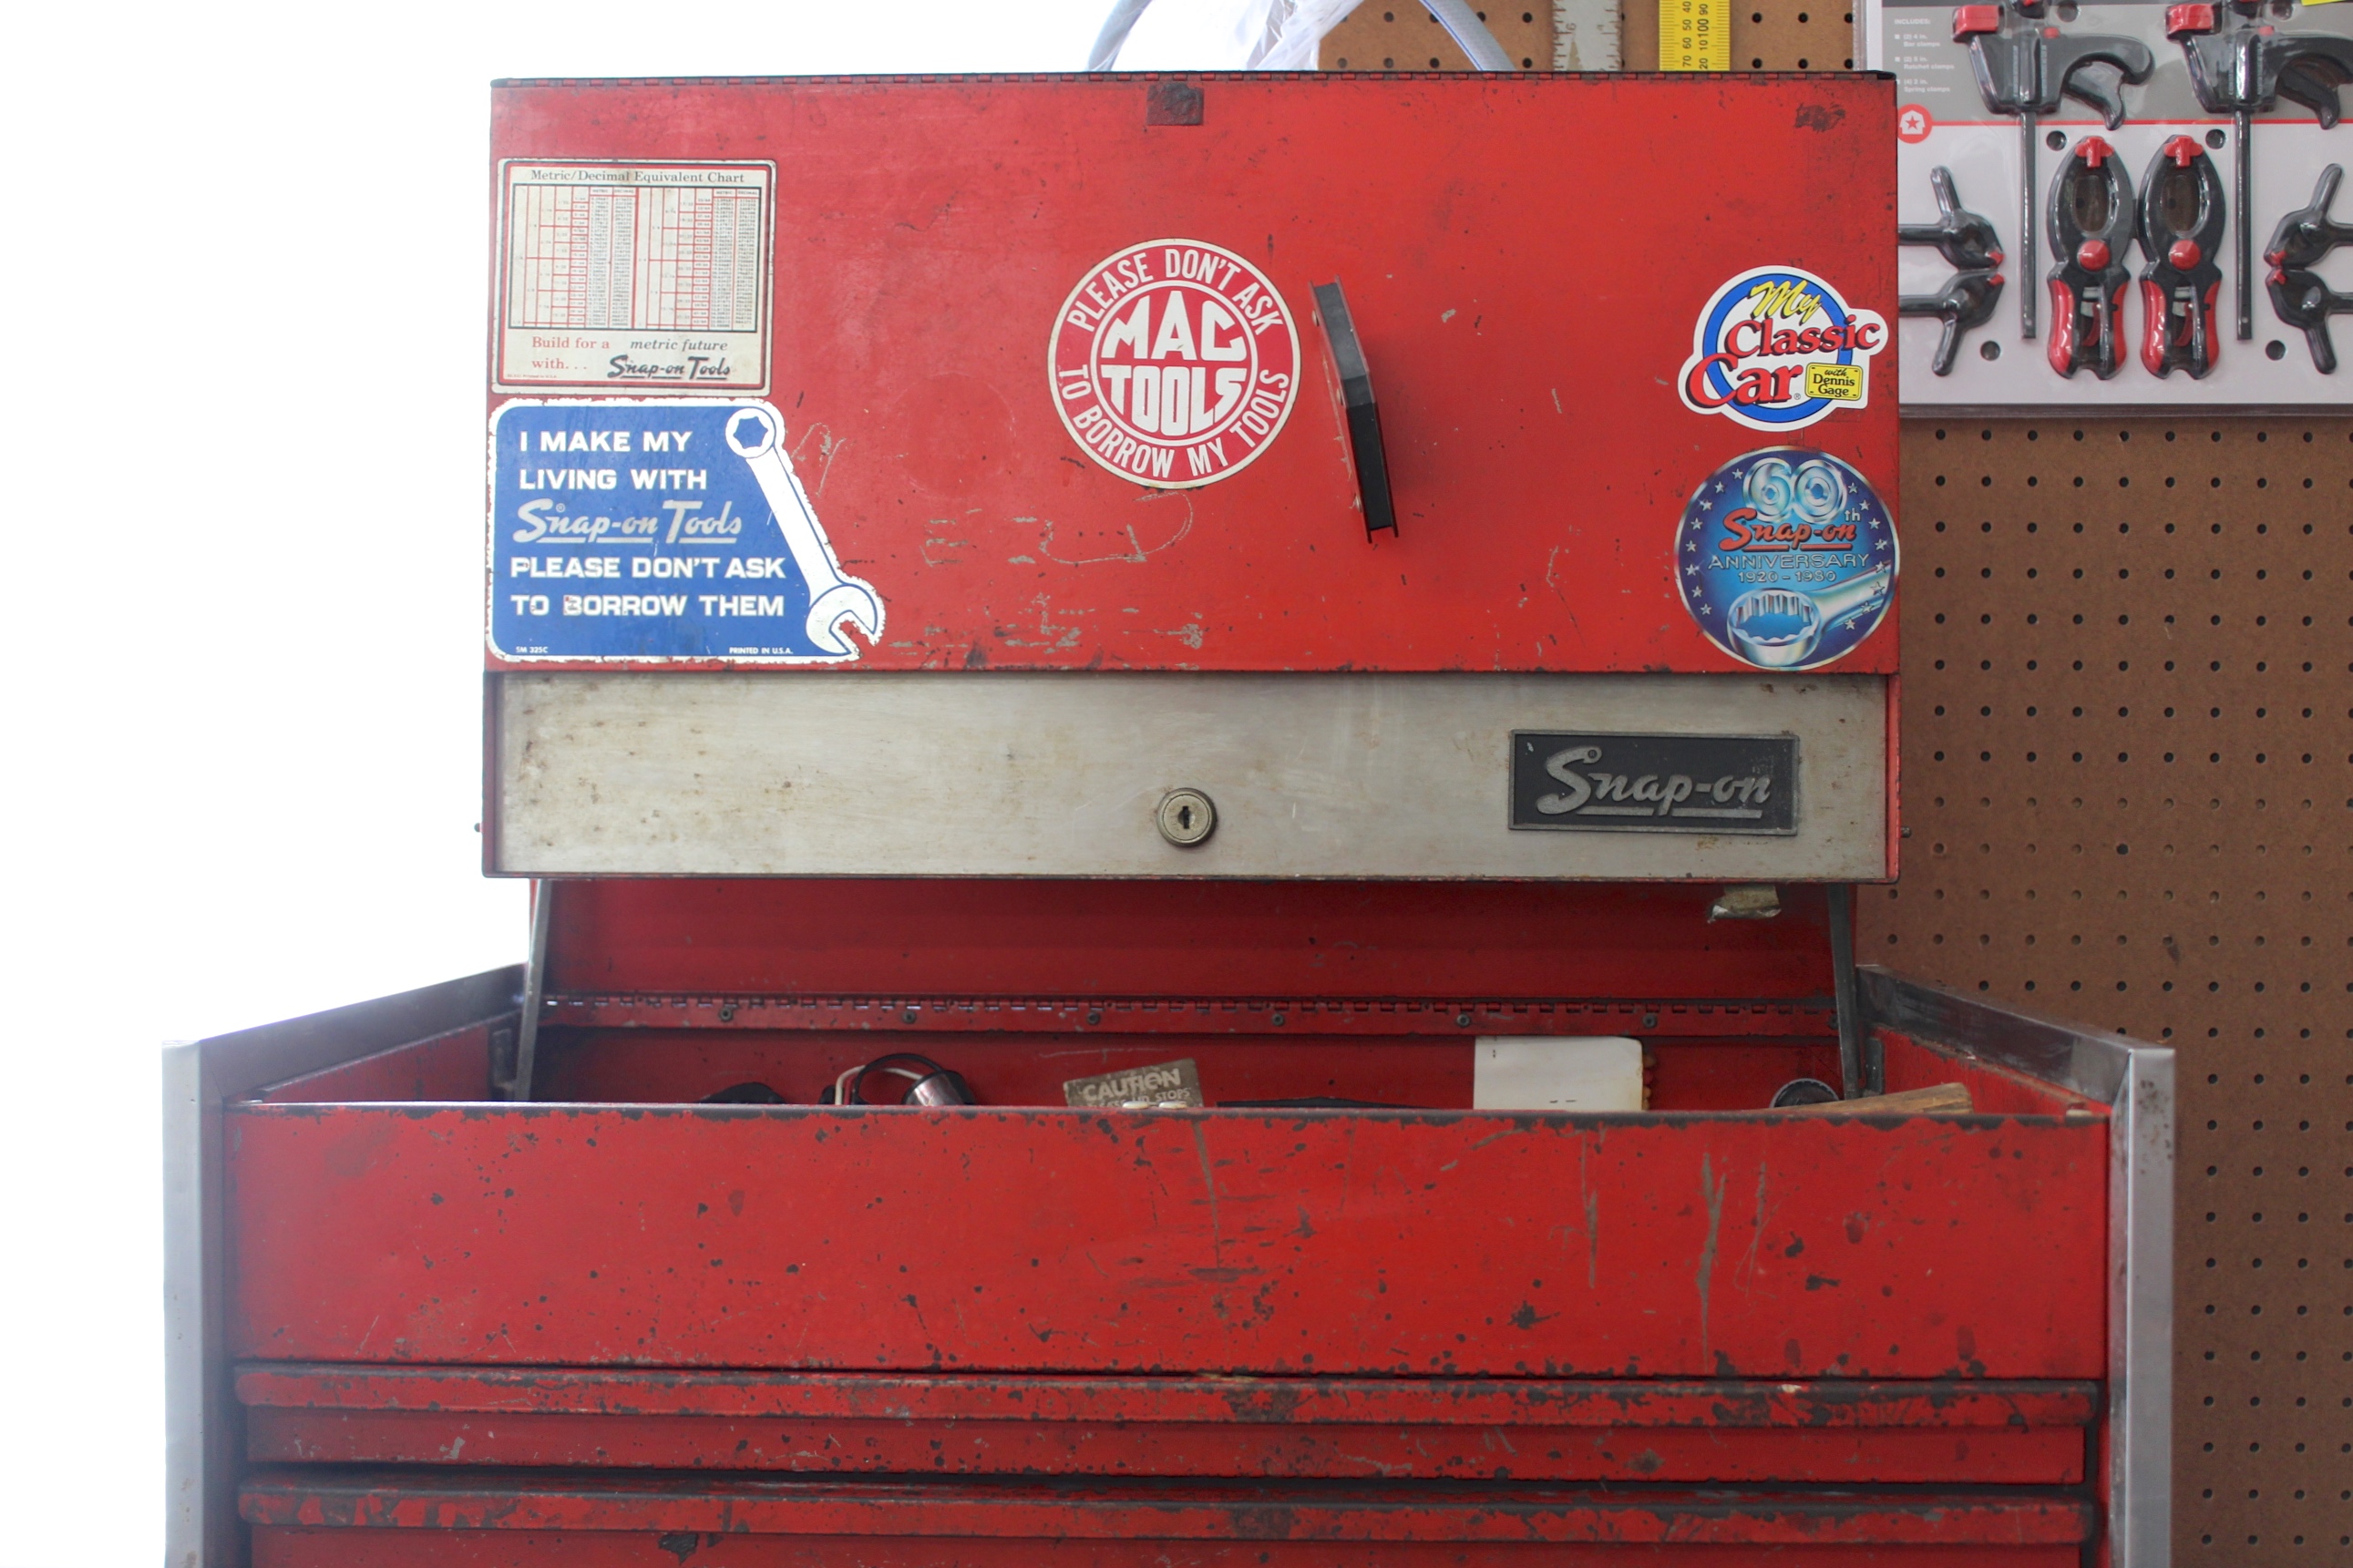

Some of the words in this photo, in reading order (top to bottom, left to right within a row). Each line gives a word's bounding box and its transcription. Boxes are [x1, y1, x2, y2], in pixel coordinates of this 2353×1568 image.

[1699, 4, 1708, 15] 90
[1683, 19, 1691, 31] 50
[1697, 18, 1709, 37] 100
[1683, 37, 1691, 49] 60
[1699, 39, 1708, 51] 10
[1683, 55, 1691, 67] 70
[1699, 57, 1708, 69] 20
[530, 169, 630, 181] Metric/Decimal
[634, 170, 704, 183] Equivalent
[707, 171, 745, 183] Chart
[1066, 252, 1154, 333] PLEASE
[1166, 248, 1241, 291] DON'T
[1232, 282, 1284, 335] ASK
[1748, 279, 1823, 326] My
[1101, 290, 1247, 362] MAC
[1724, 314, 1881, 357] Classic
[532, 336, 570, 349] Build
[575, 337, 597, 349] for
[601, 341, 611, 349] a
[630, 338, 678, 350] metric
[681, 339, 728, 353] future
[607, 354, 685, 379] Snap-on
[687, 355, 731, 380] Tools
[1824, 367, 1847, 376] with
[1058, 364, 1092, 401] TO
[1686, 353, 1803, 409] Car
[1813, 374, 1855, 386] Dennis
[1818, 384, 1849, 397] Gage
[1100, 364, 1248, 436] TOOLS
[1229, 369, 1290, 448] TOOLS
[520, 431, 527, 452] I
[540, 431, 631, 452] MAKE
[642, 431, 693, 452] MY
[1073, 405, 1175, 478] BORROW
[1187, 437, 1228, 477] MY
[519, 469, 617, 490] LIVING
[631, 469, 707, 490] WITH
[1742, 456, 1847, 526] 60
[1844, 507, 1861, 523] th
[512, 498, 659, 543] Snap-on
[662, 500, 743, 543] Tools
[1719, 507, 1857, 552] Snap-on
[510, 557, 621, 579] PLEASE
[632, 557, 720, 579] DON'T
[724, 557, 786, 579] ASK
[1707, 553, 1870, 570] ANNIVERSARY
[1738, 570, 1778, 582] 1920
[510, 595, 549, 617] TO
[563, 595, 688, 617] BORROW
[698, 595, 784, 617] THEM
[729, 646, 759, 654] PRINTED
[1536, 744, 1772, 818] Snap-on
[1083, 1068, 1182, 1101] CAUTION
